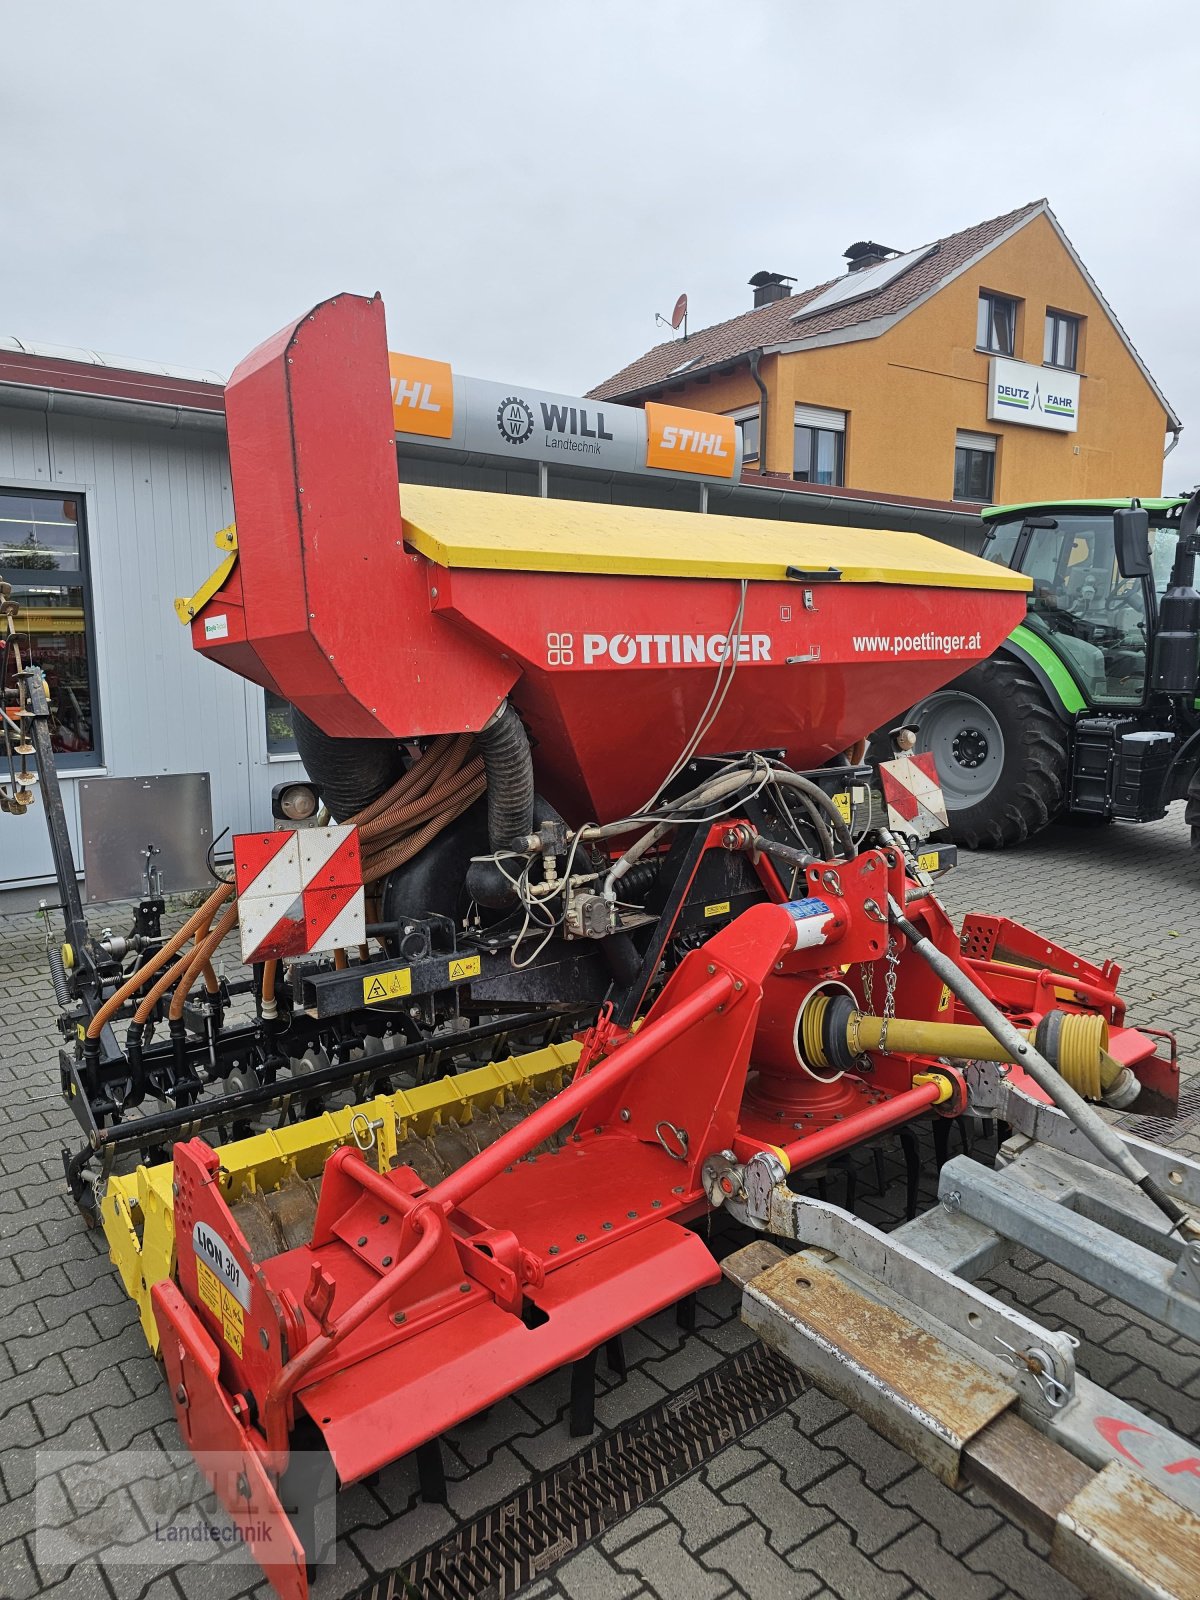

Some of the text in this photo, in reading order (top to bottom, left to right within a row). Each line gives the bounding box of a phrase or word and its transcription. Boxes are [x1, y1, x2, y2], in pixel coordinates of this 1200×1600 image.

[998, 385, 1072, 407] DEUTZ FAHR
[540, 402, 613, 440] WILL
[545, 435, 601, 454] Landtechnik
[660, 426, 728, 457] STIHL
[583, 633, 772, 665] PÖTTINGER
[852, 631, 981, 656] www.poettinger.at
[197, 1226, 223, 1269] LION
[225, 1257, 240, 1288] 301
